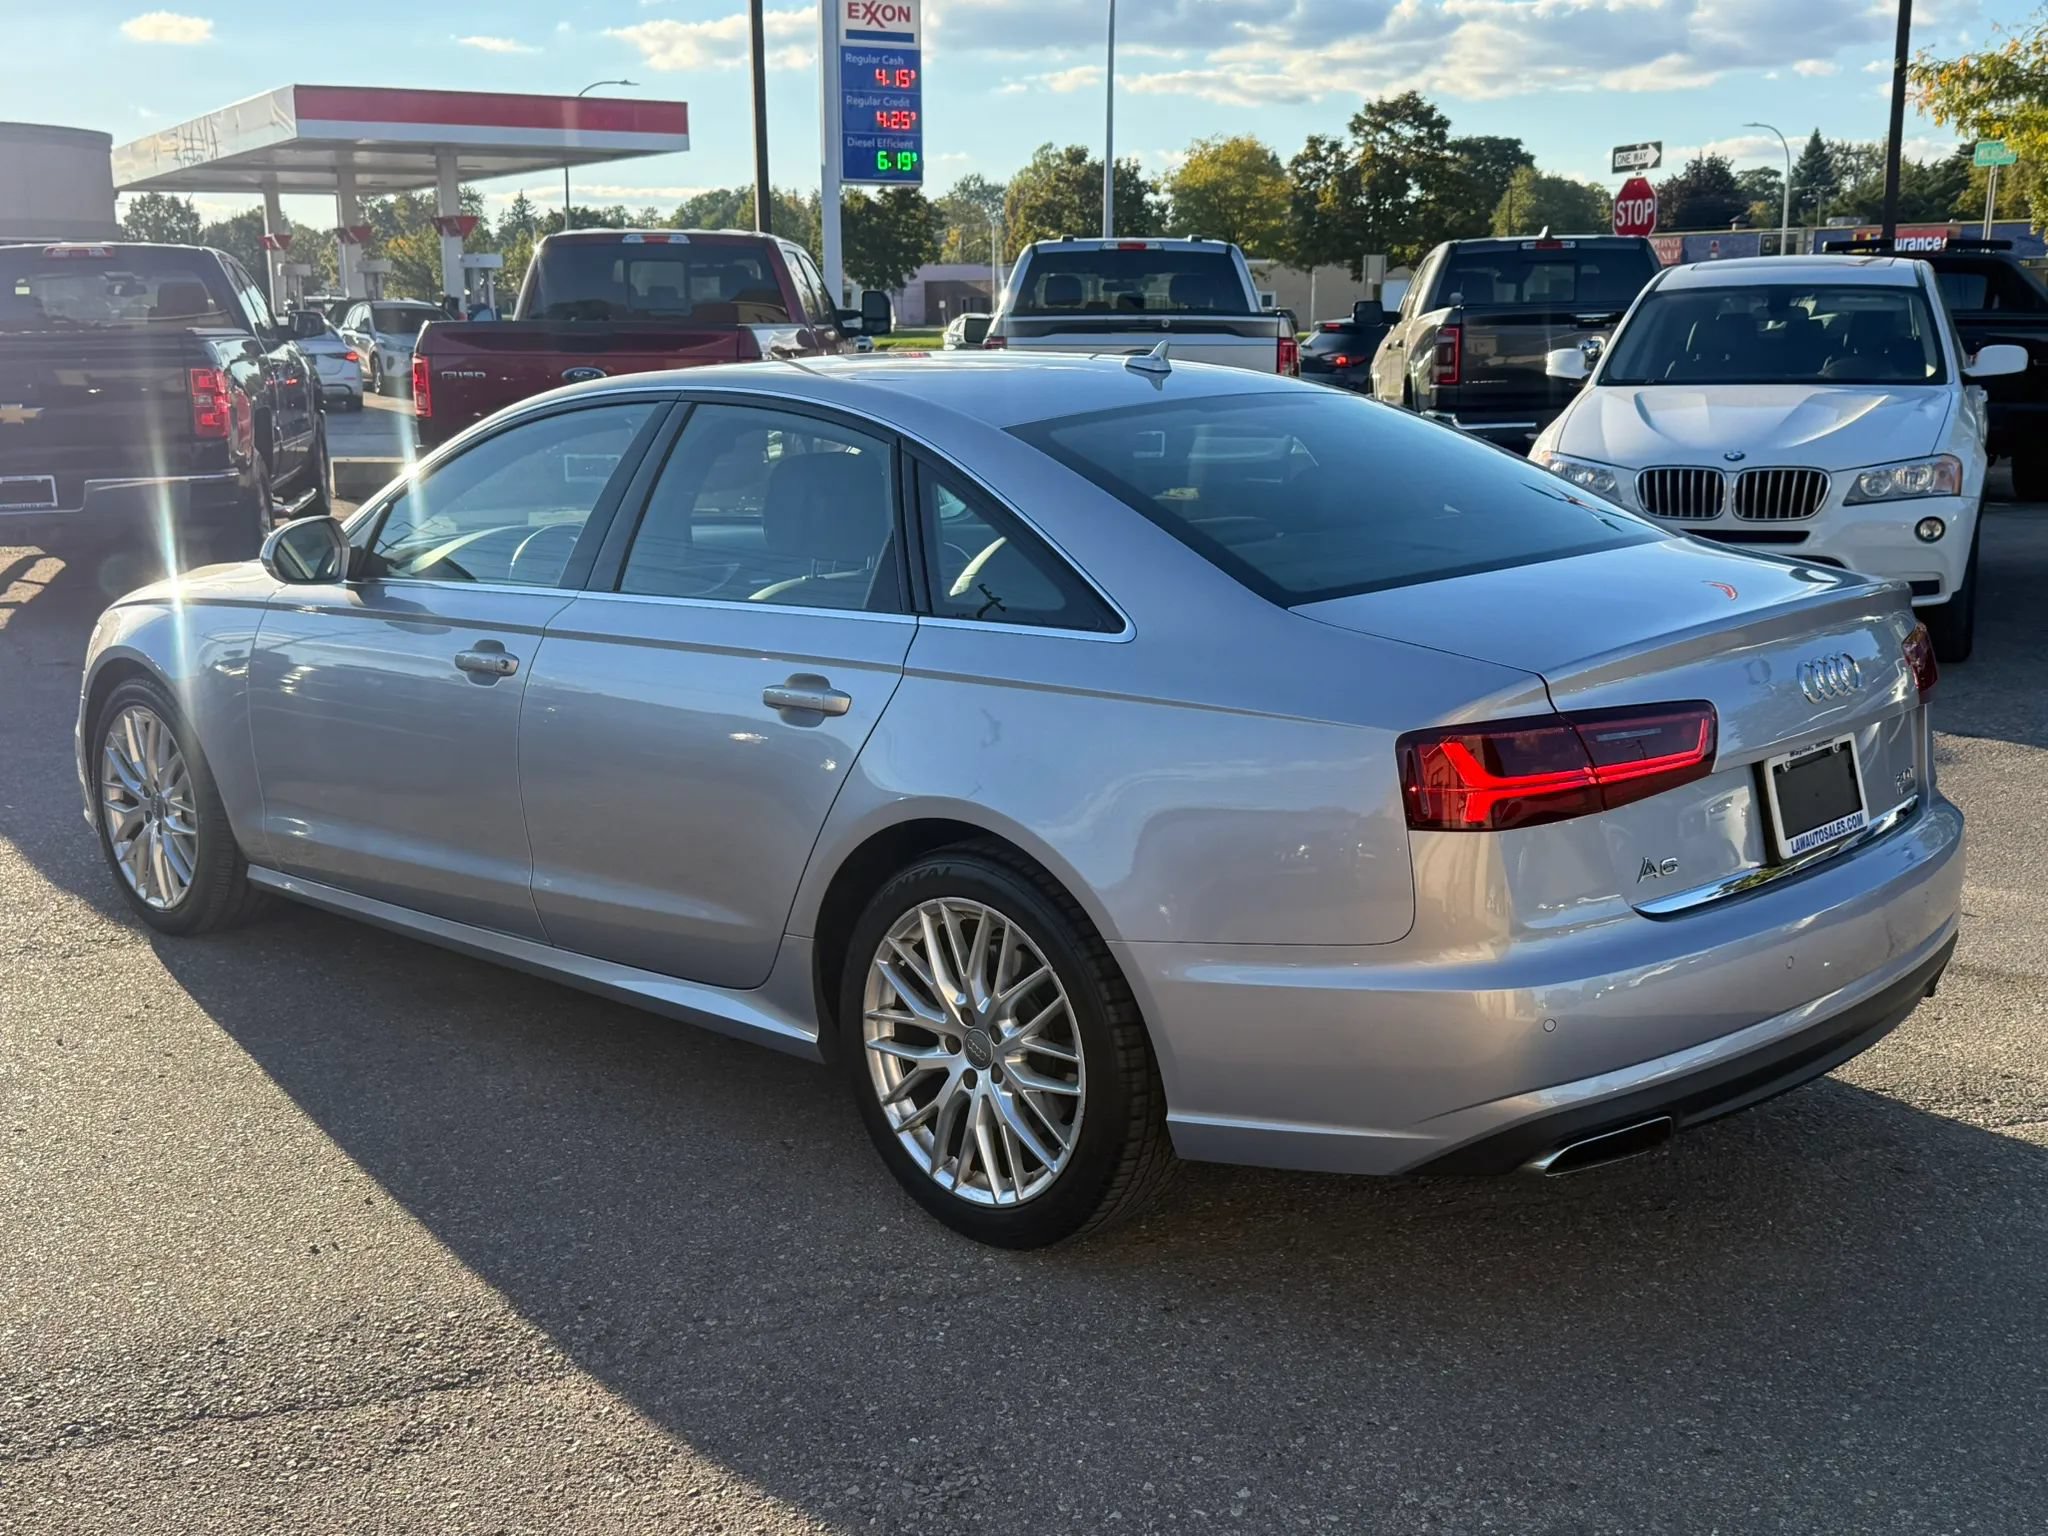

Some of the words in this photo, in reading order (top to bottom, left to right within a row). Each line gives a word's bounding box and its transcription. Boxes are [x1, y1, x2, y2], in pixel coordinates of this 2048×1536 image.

[848, 0, 911, 28] EXXON
[845, 52, 880, 66] Regular
[882, 55, 904, 65] Cash
[846, 95, 880, 108] Regular
[883, 97, 910, 107] Credit
[847, 136, 875, 148] Diesel
[877, 137, 914, 149] Efficient
[1616, 153, 1632, 166] ONE
[1633, 151, 1648, 163] WAY
[1616, 198, 1653, 227] STOP
[1790, 811, 1865, 855] LAWAUTOSALES.COM
[1636, 856, 1678, 884] A6
